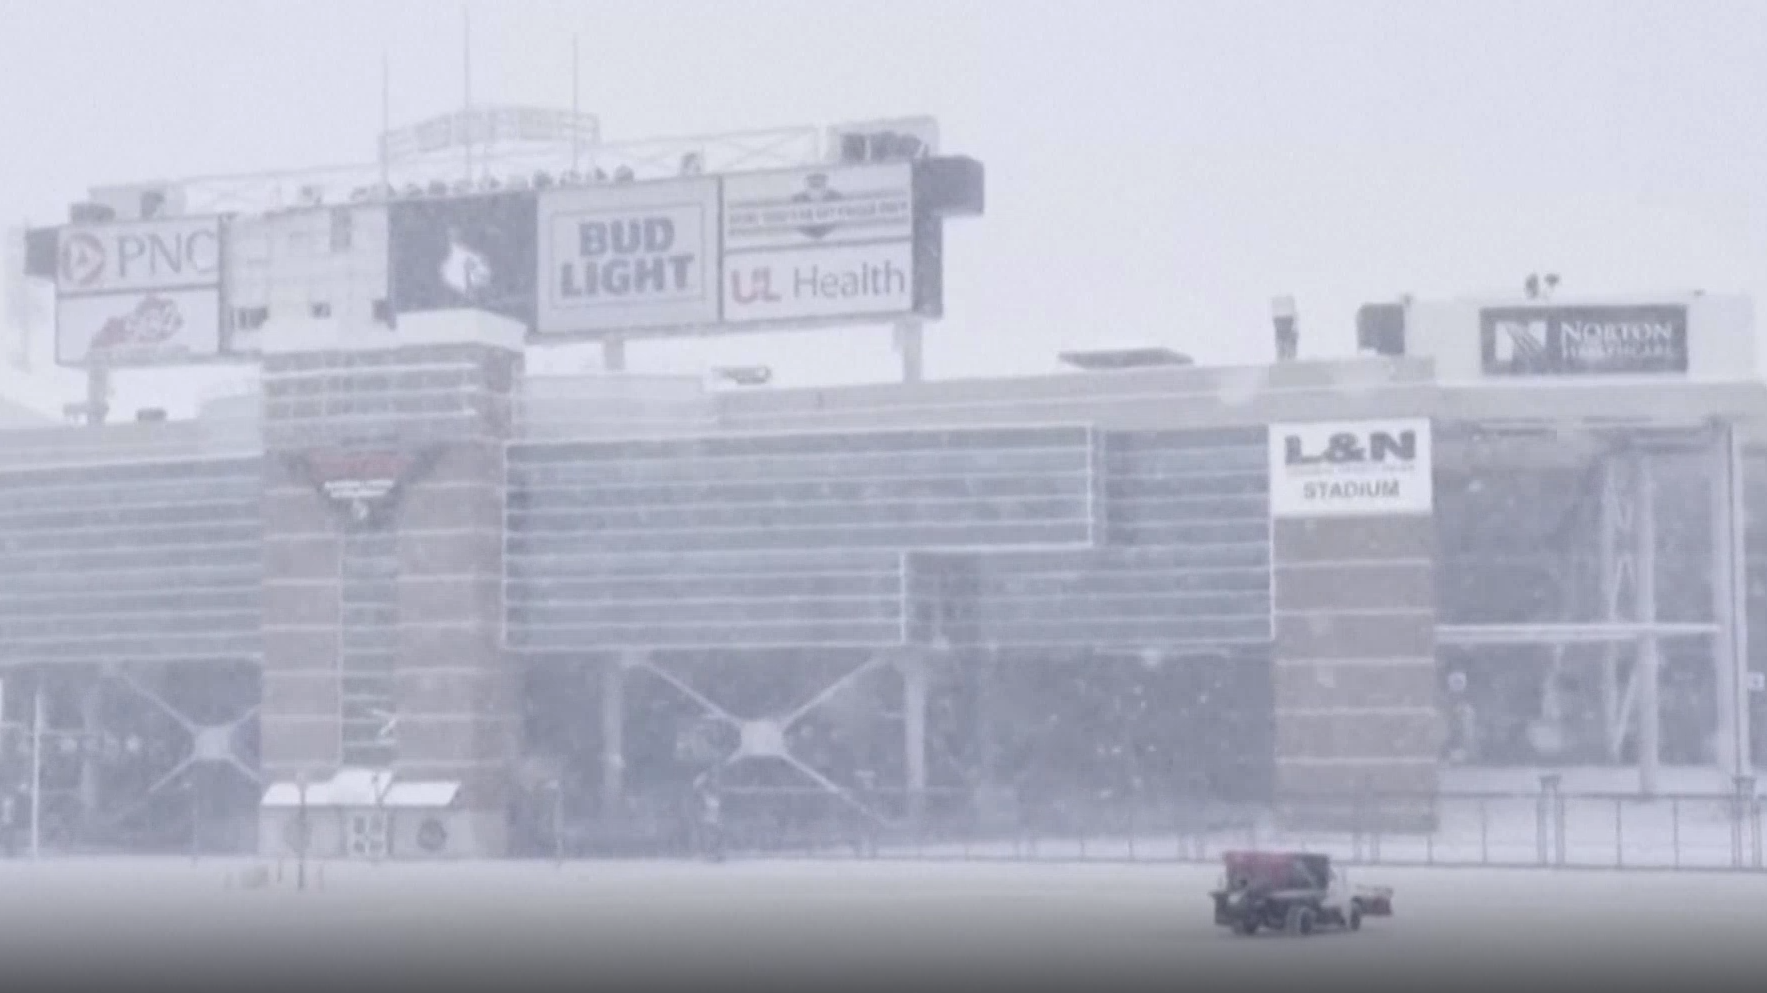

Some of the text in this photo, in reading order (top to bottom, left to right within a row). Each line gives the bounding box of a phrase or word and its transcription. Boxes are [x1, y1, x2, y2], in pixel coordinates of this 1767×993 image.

[117, 229, 216, 278] PNC
[579, 217, 675, 257] BUD
[561, 253, 696, 298] LIGHT
[794, 260, 905, 298] Health
[1284, 430, 1416, 465] L&N
[1303, 479, 1400, 499] STADIUM
